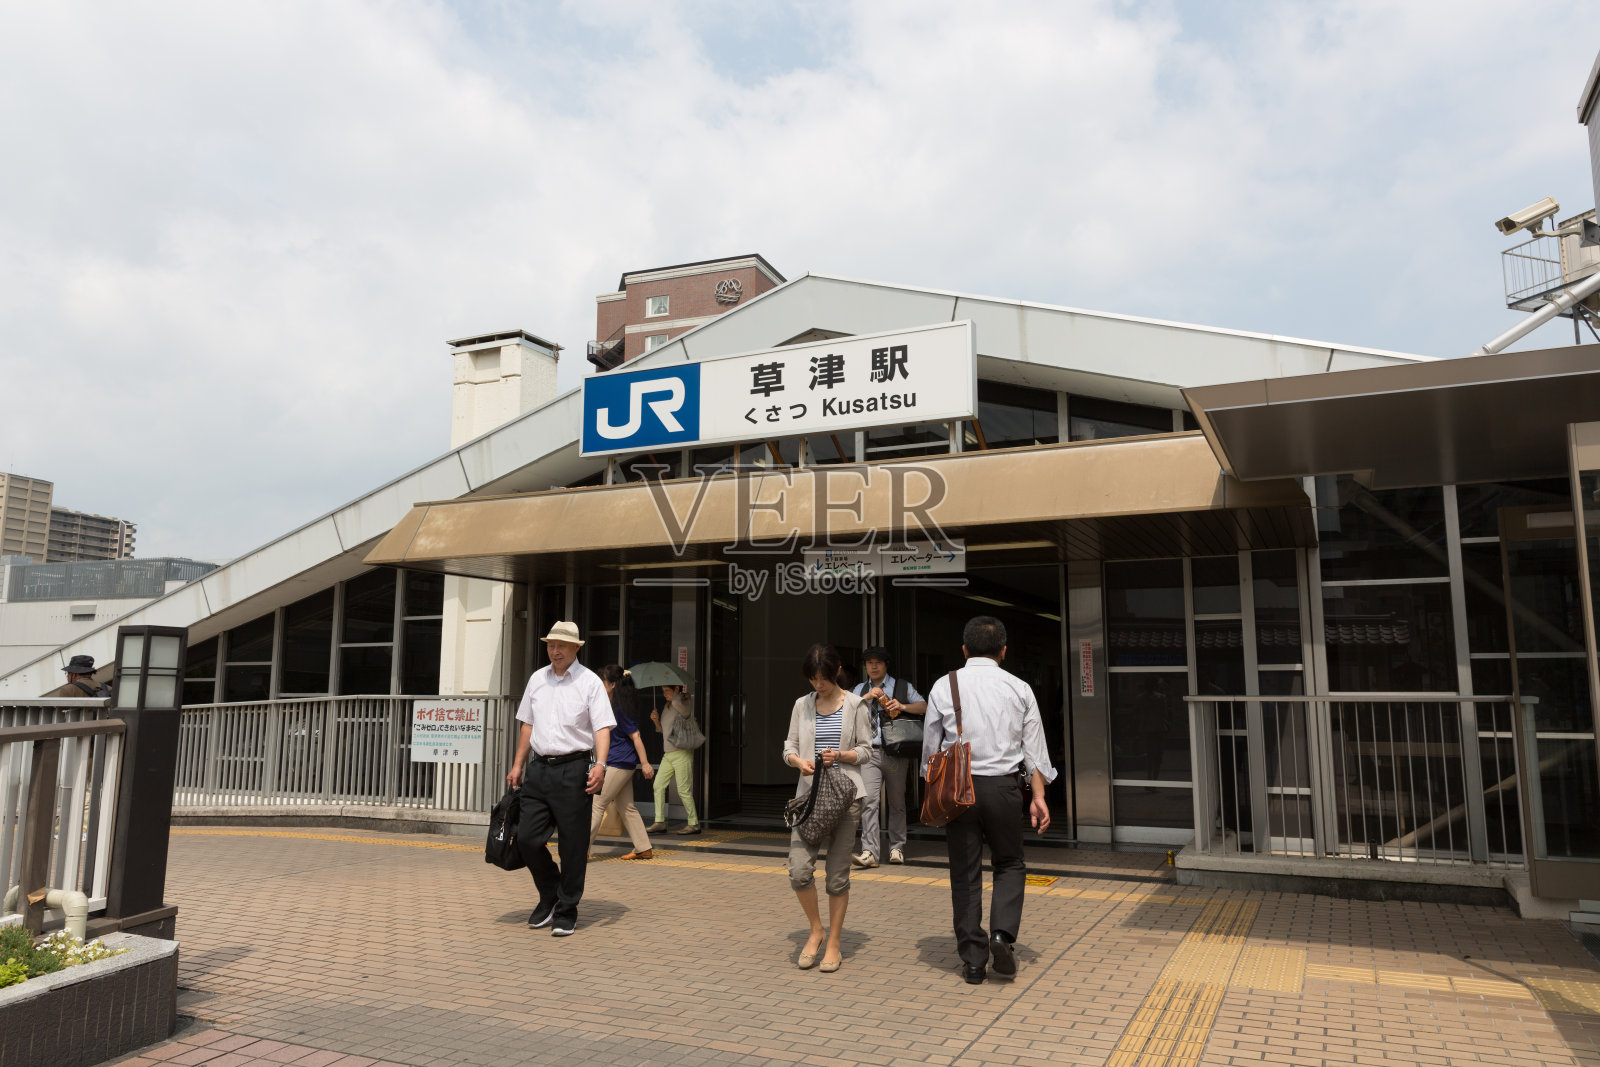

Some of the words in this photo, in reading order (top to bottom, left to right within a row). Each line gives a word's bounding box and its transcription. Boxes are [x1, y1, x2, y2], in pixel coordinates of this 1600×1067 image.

[750, 344, 910, 398] 草津駅
[596, 376, 686, 440] JR
[744, 403, 807, 425] くさつ
[822, 390, 917, 418] Kusatsu
[891, 552, 942, 564] エレベーター
